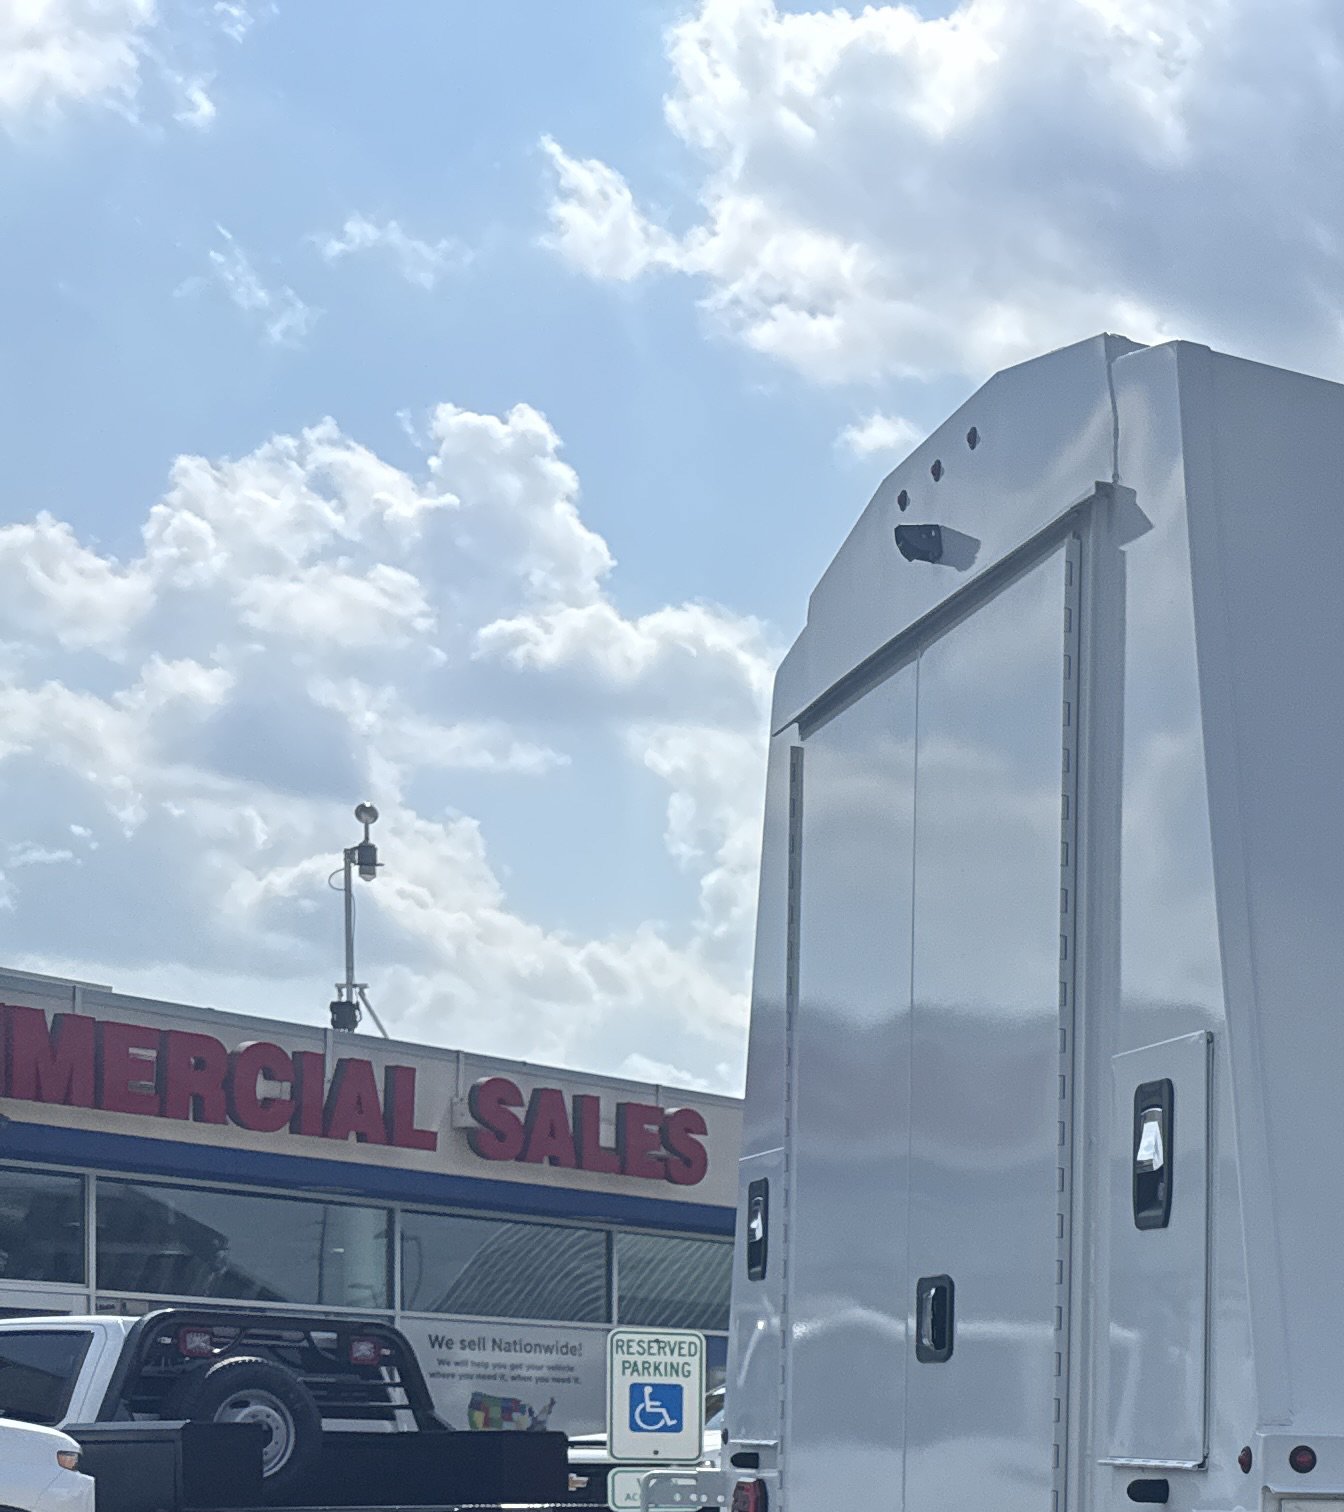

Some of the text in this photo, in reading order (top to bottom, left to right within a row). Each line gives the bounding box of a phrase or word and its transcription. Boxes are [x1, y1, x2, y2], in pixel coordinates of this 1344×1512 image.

[0, 1003, 708, 1186] MERCIAL SALES
[428, 1333, 583, 1357] We sell Nationwide!
[615, 1338, 698, 1357] RESERVED
[621, 1360, 692, 1378] PARKING
